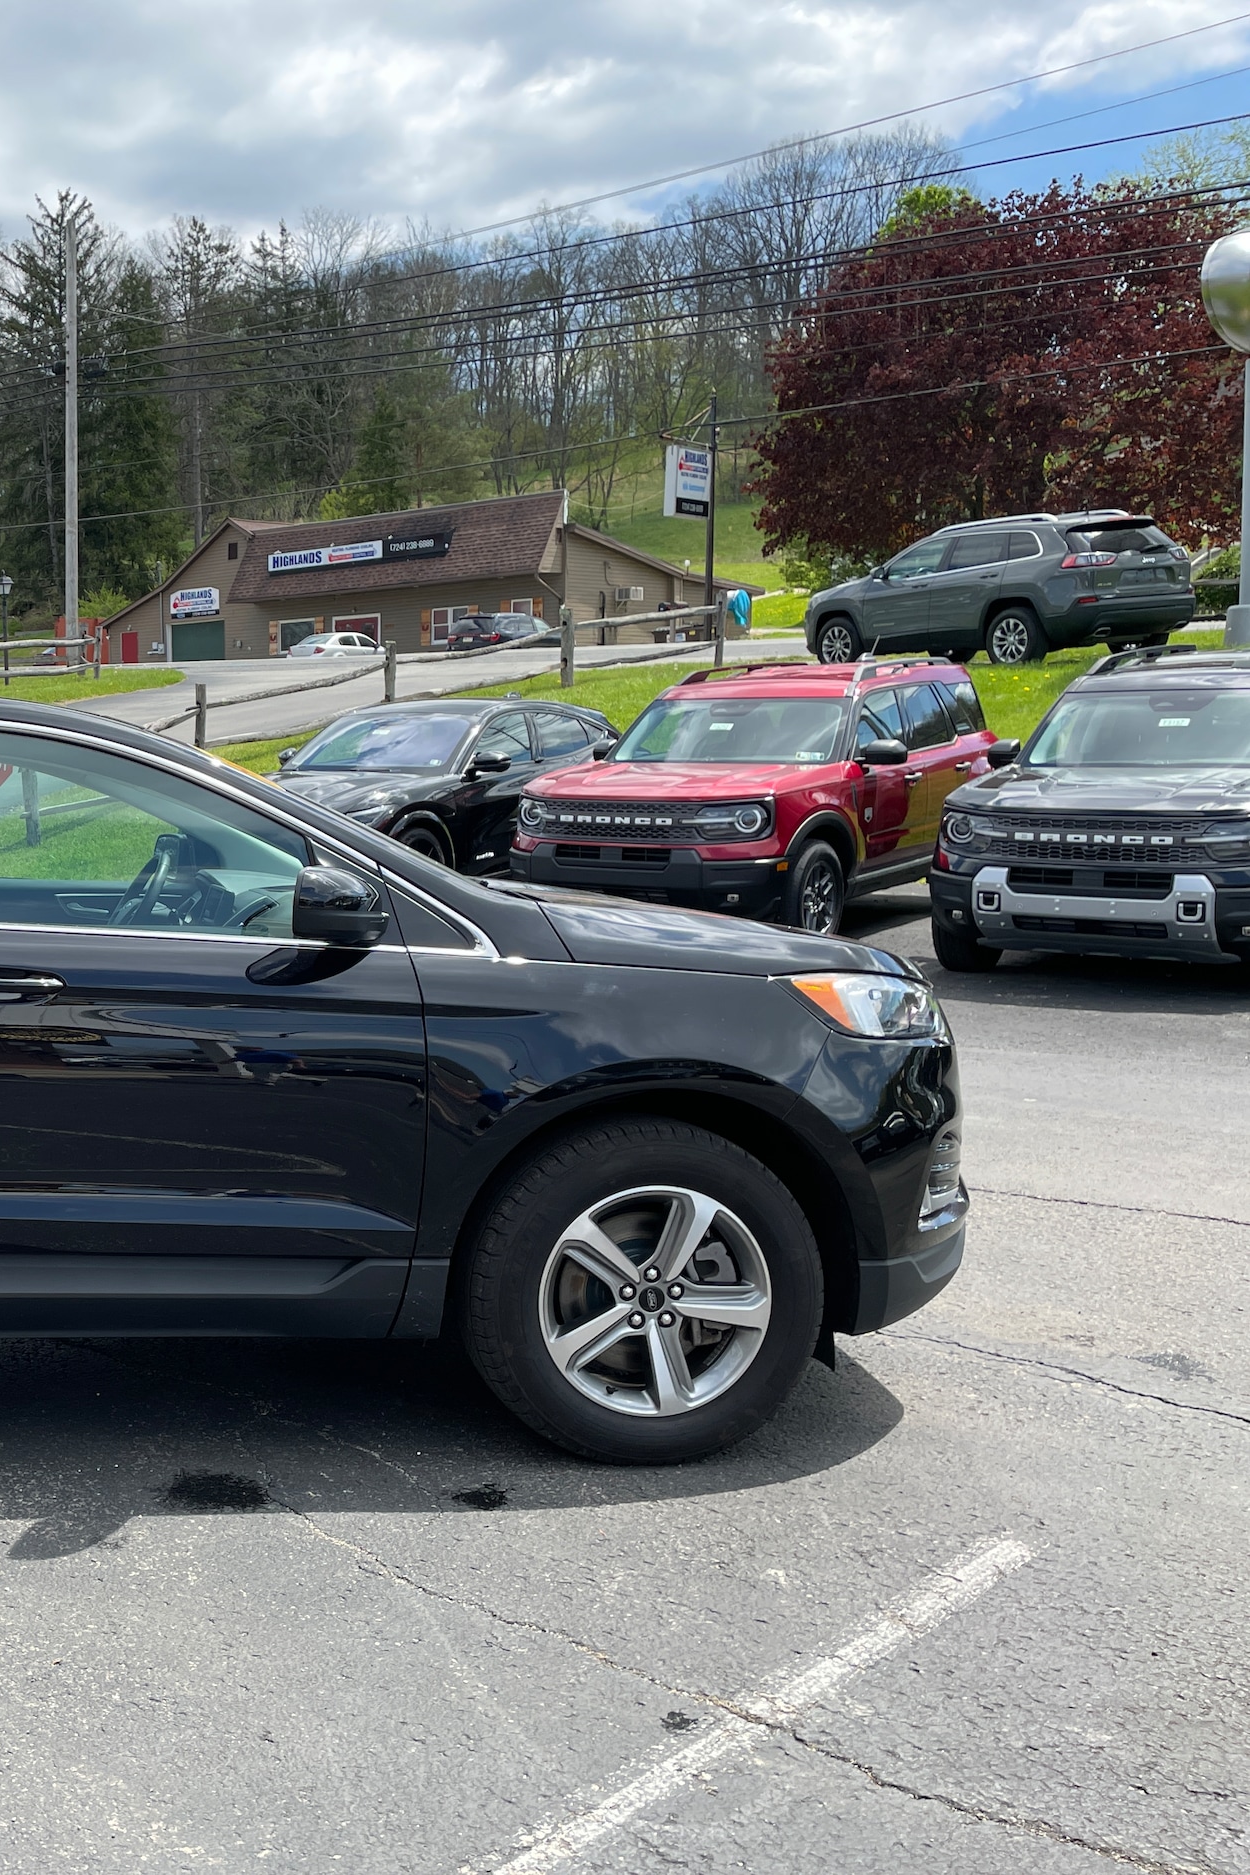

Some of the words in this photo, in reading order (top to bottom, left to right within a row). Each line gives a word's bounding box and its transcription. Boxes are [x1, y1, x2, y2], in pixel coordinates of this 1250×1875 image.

[272, 551, 322, 568] HIGHLANDS
[180, 589, 212, 601] HIGHLANDS
[559, 814, 673, 826] BRONCO
[1014, 831, 1174, 845] BRONCO
